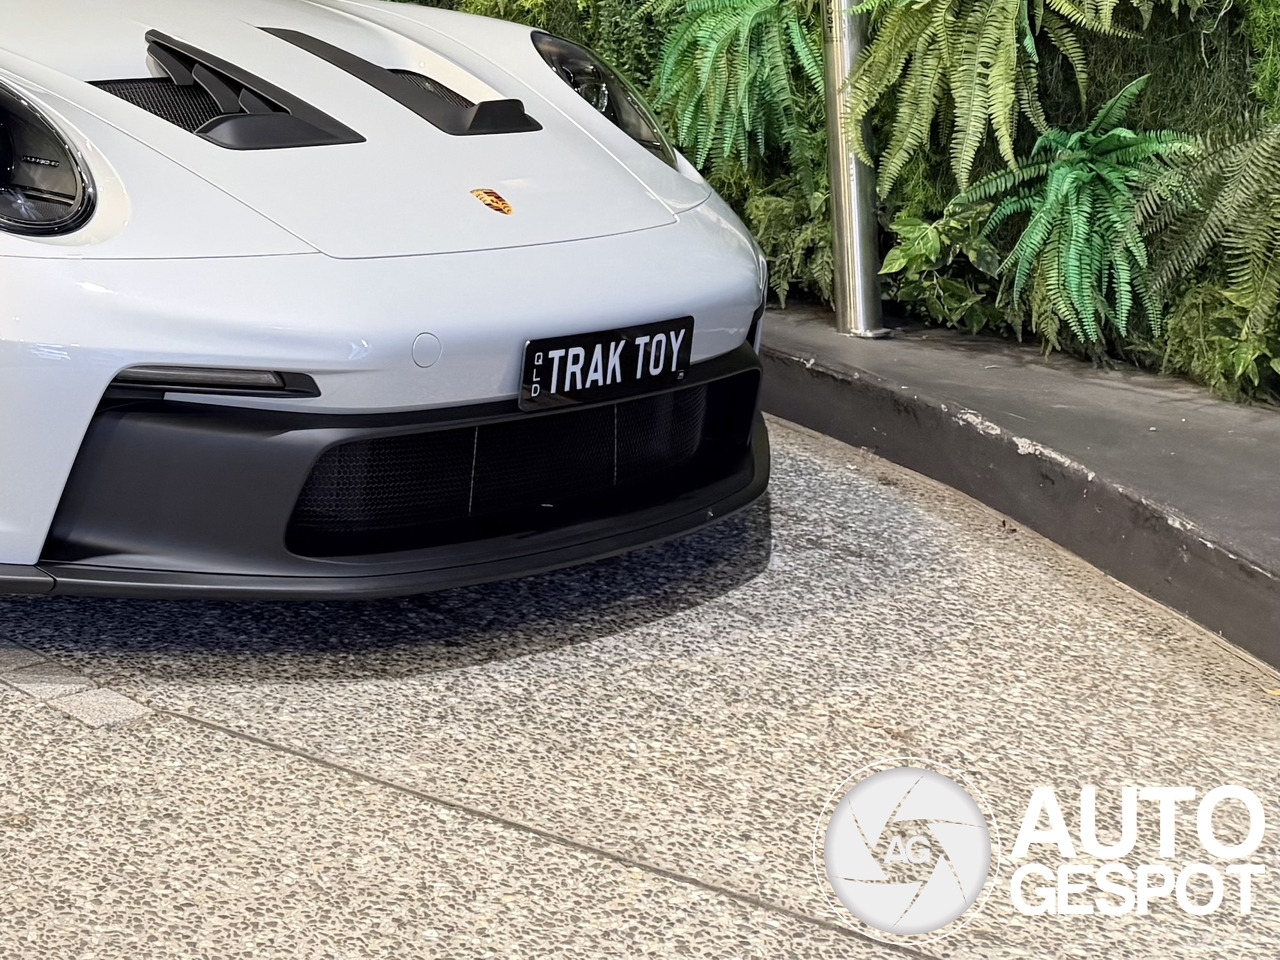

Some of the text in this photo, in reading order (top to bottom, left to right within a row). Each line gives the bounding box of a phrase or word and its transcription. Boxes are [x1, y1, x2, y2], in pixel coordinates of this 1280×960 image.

[531, 352, 543, 397] QLD
[548, 328, 686, 394] TRAK TOY
